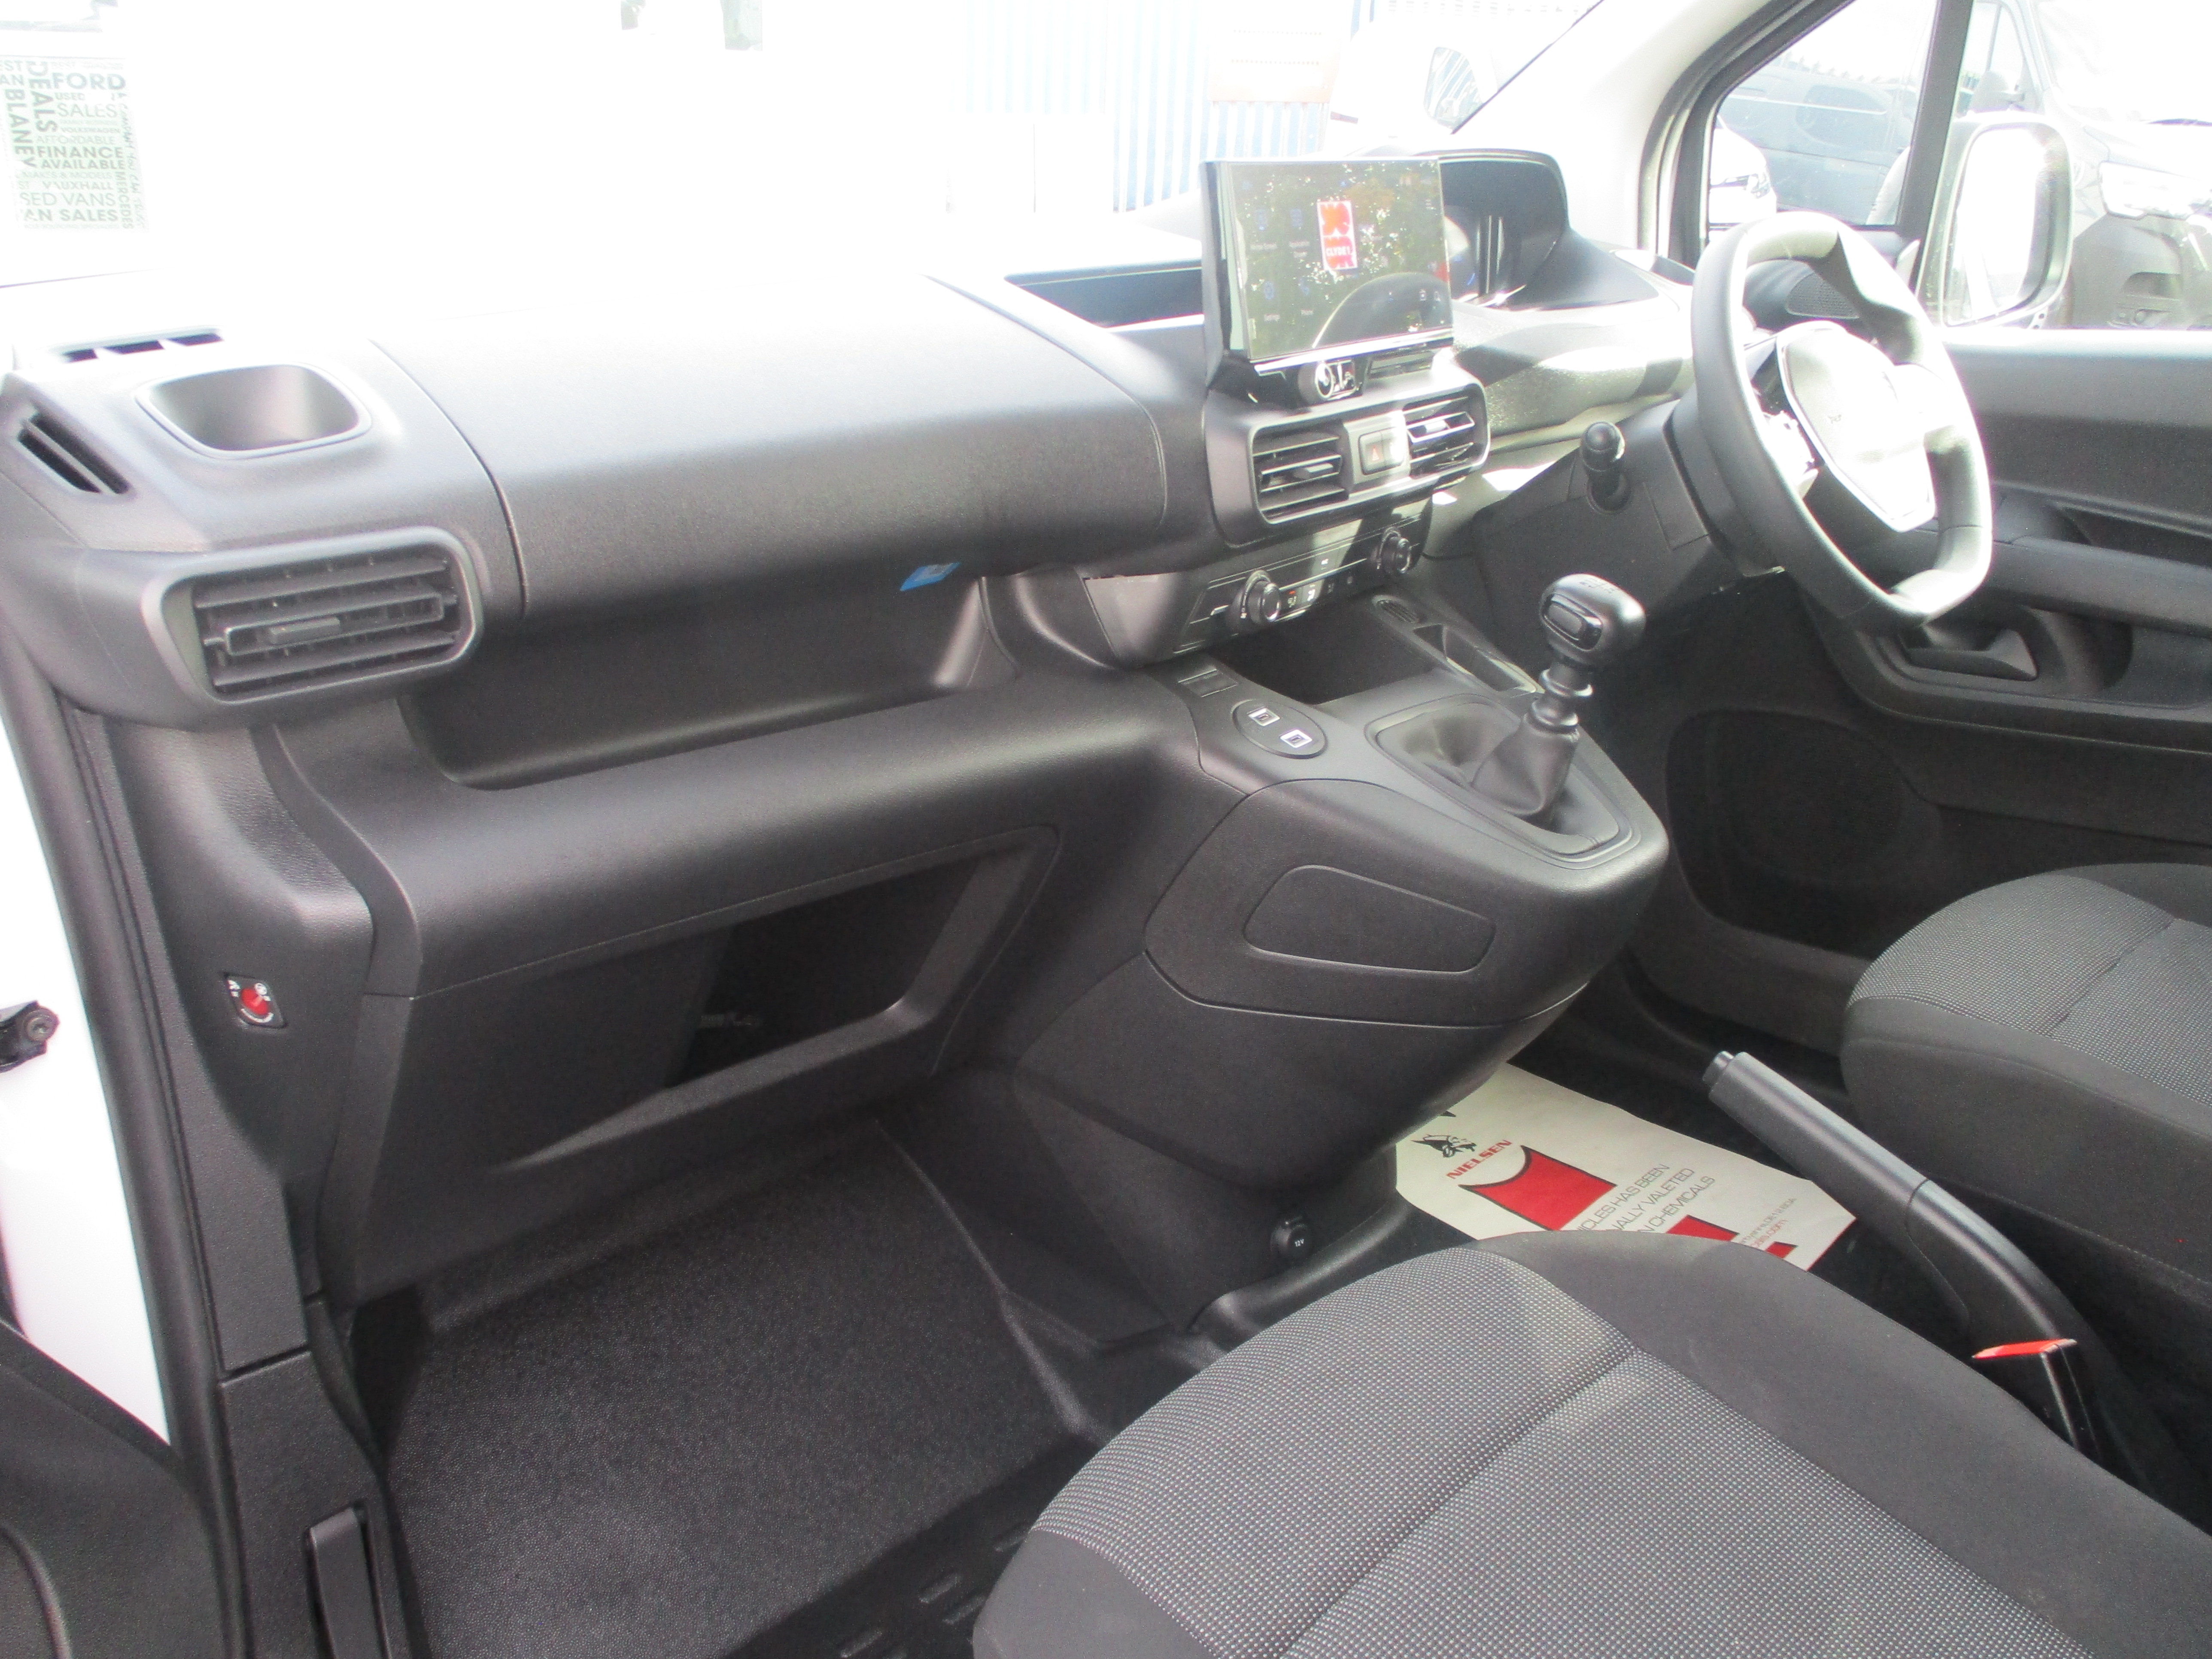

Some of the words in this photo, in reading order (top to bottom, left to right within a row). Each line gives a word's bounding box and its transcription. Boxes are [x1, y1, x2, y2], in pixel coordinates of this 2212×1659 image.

[52, 72, 126, 90] FORD
[26, 61, 58, 132] DEALS
[58, 103, 118, 118] SALES
[5, 88, 37, 168] BLANEY
[37, 146, 124, 159] FINANCE
[42, 159, 126, 170] AVAILABLE
[62, 192, 116, 206] VANS
[116, 172, 134, 229] MERCEDES
[61, 209, 118, 222] SALES
[1446, 1139, 1512, 1179] NIELSEN
[1577, 1205, 1616, 1231] ICLES
[1610, 1185, 1641, 1207] HAS
[1635, 1164, 1670, 1188] BEEN
[1641, 1167, 1695, 1205] VALETED
[1648, 1176, 1715, 1227] CHEMICALS
[1295, 1238, 1304, 1247] 12V
